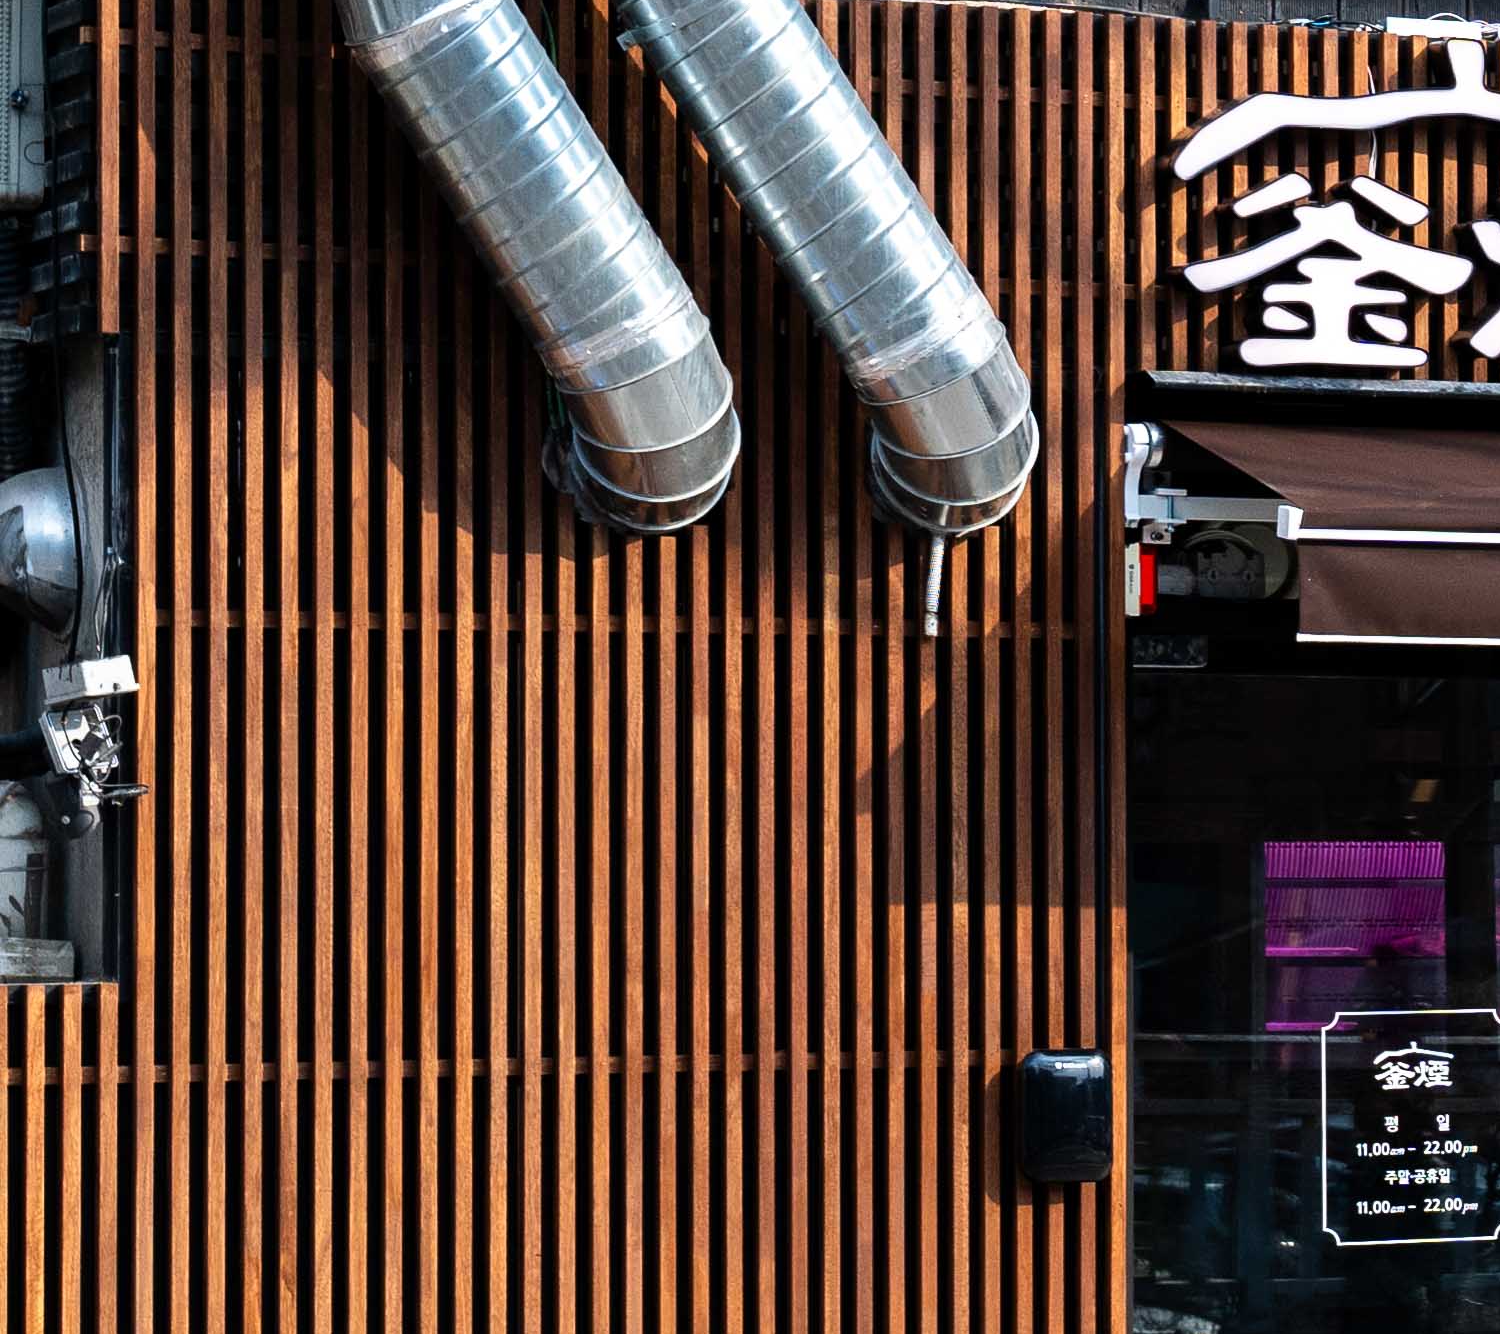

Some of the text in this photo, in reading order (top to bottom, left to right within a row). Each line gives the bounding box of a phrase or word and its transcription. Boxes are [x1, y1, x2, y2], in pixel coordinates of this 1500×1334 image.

[1374, 1060, 1453, 1090] 釜煙
[1384, 1113, 1450, 1133] 평 일
